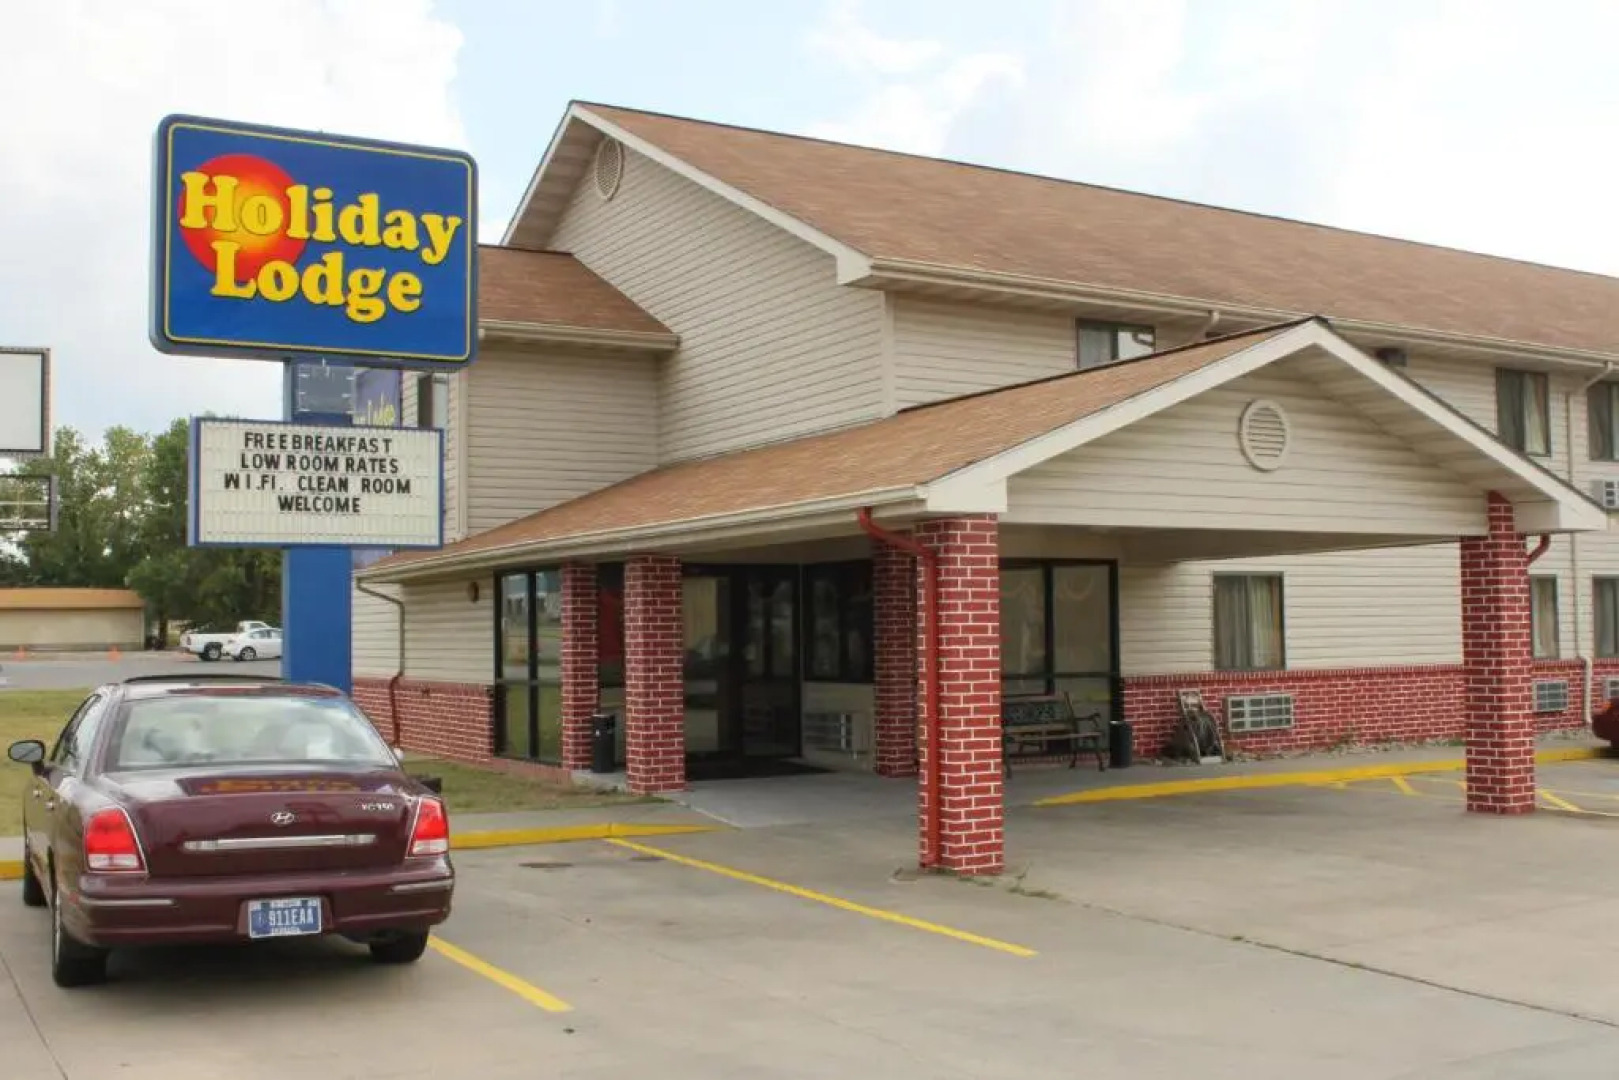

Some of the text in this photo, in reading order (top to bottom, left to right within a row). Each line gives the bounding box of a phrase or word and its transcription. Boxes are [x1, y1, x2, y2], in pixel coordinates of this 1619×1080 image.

[179, 170, 463, 265] Holiday
[210, 240, 424, 323] Lodge
[240, 452, 399, 474] LOW ROOM RATES
[297, 475, 349, 493] CLEAN
[361, 477, 411, 494] ROOM
[278, 494, 361, 513] WELCOME
